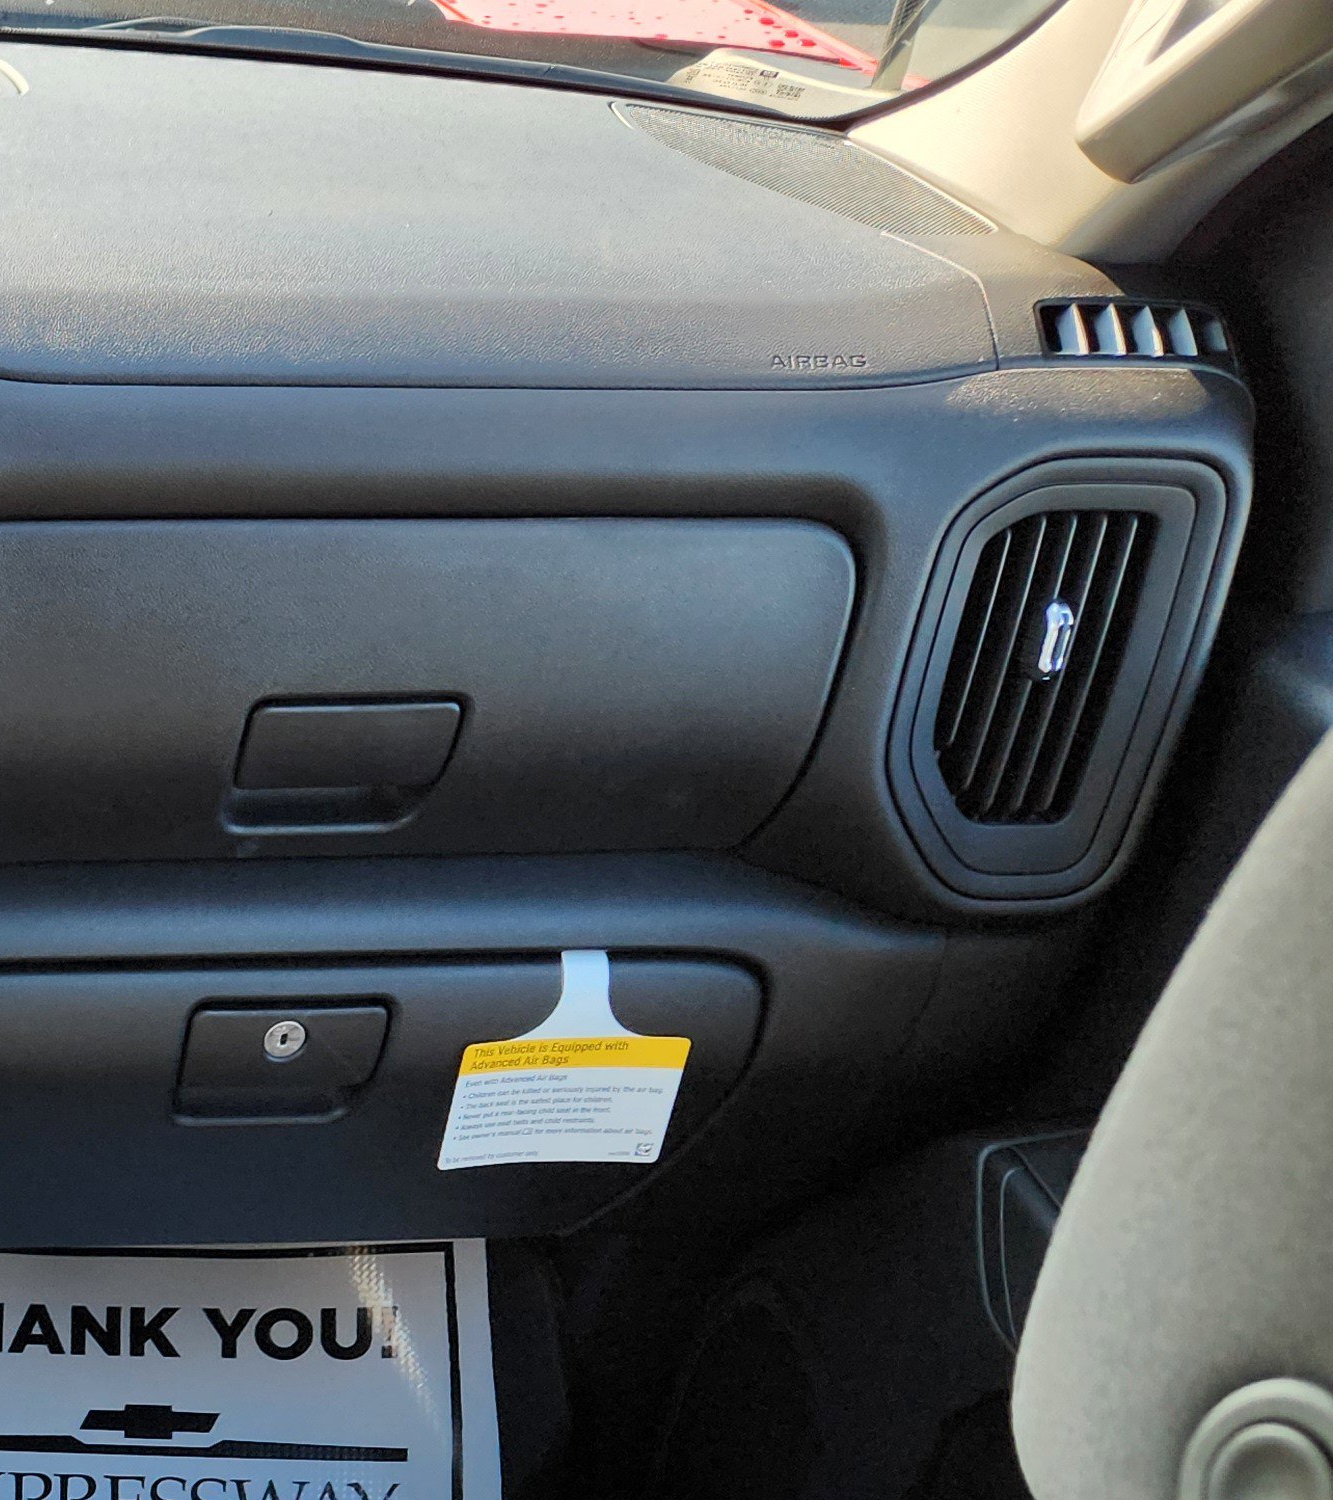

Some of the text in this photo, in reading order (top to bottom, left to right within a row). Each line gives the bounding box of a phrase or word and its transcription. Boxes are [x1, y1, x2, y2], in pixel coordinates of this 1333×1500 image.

[771, 353, 867, 369] AIRBAG
[474, 1041, 629, 1058] This Vehicle is Equipped with
[470, 1055, 569, 1071] Advanced Air Bags
[202, 1305, 400, 1362] YOU!
